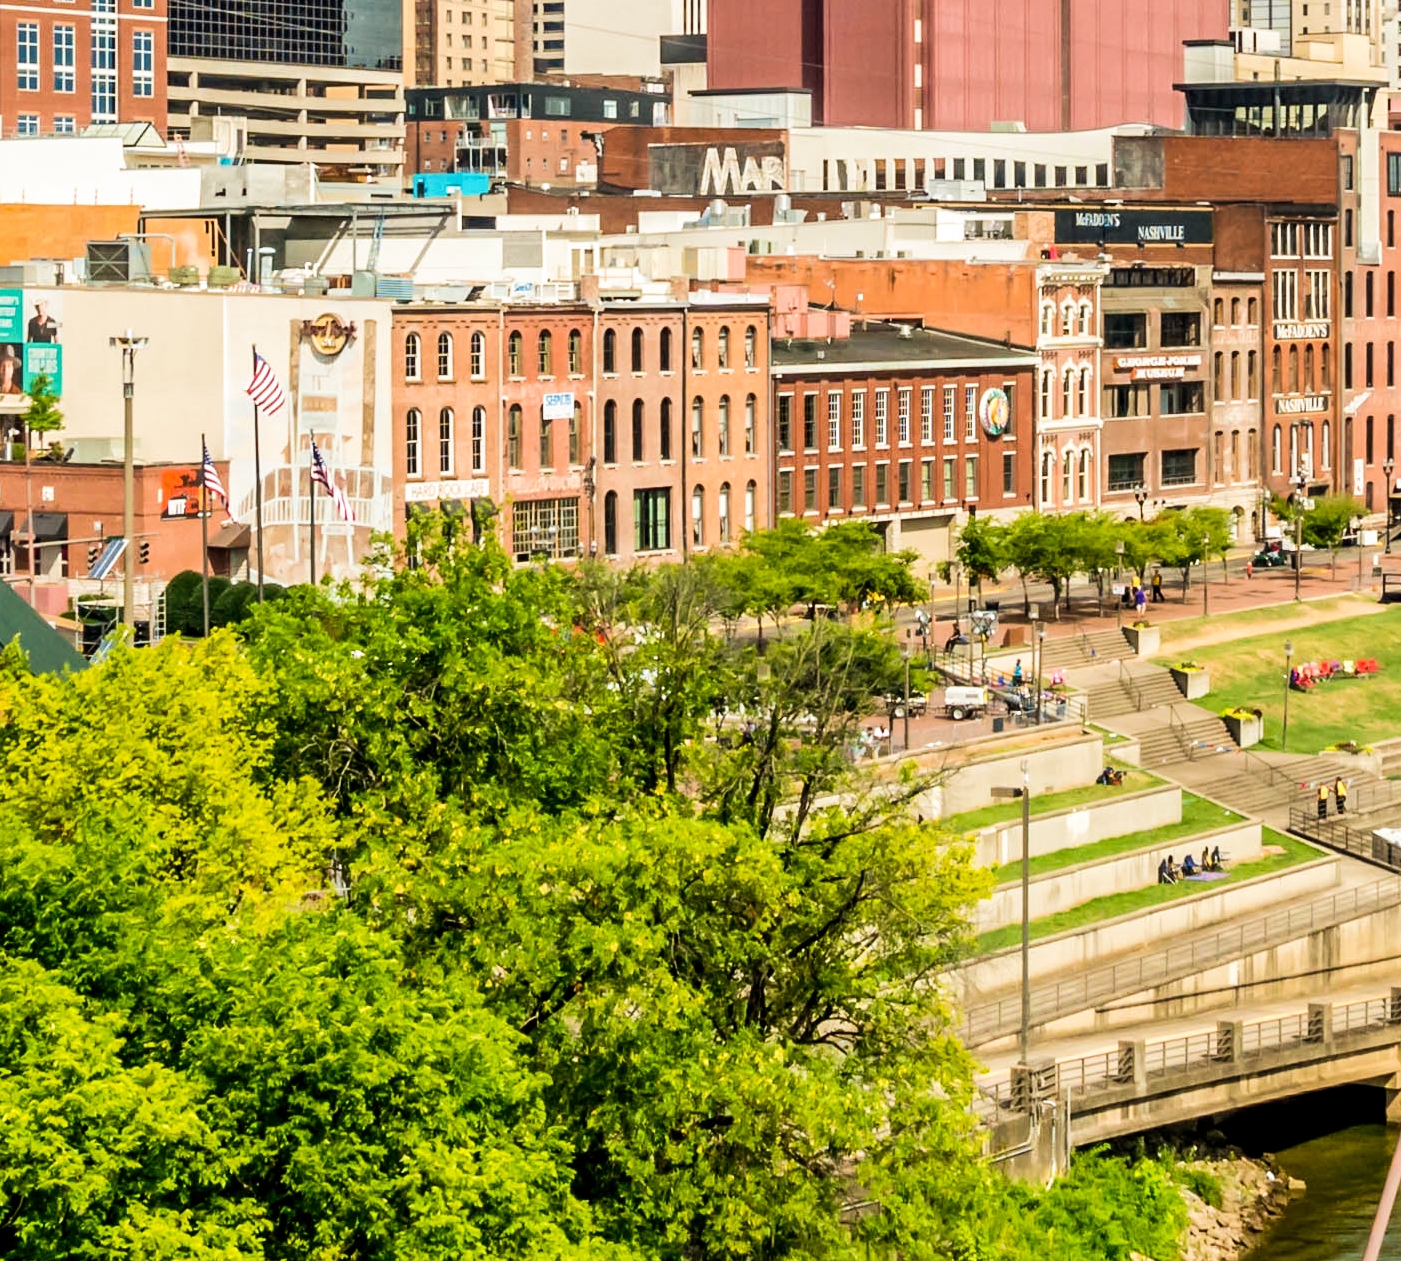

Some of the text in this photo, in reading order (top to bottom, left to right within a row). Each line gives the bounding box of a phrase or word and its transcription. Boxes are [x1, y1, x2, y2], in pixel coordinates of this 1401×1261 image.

[1137, 225, 1185, 240] NASHVILLE
[1276, 323, 1328, 339] McFADDEN'S
[1278, 396, 1325, 414] NASHVILLE
